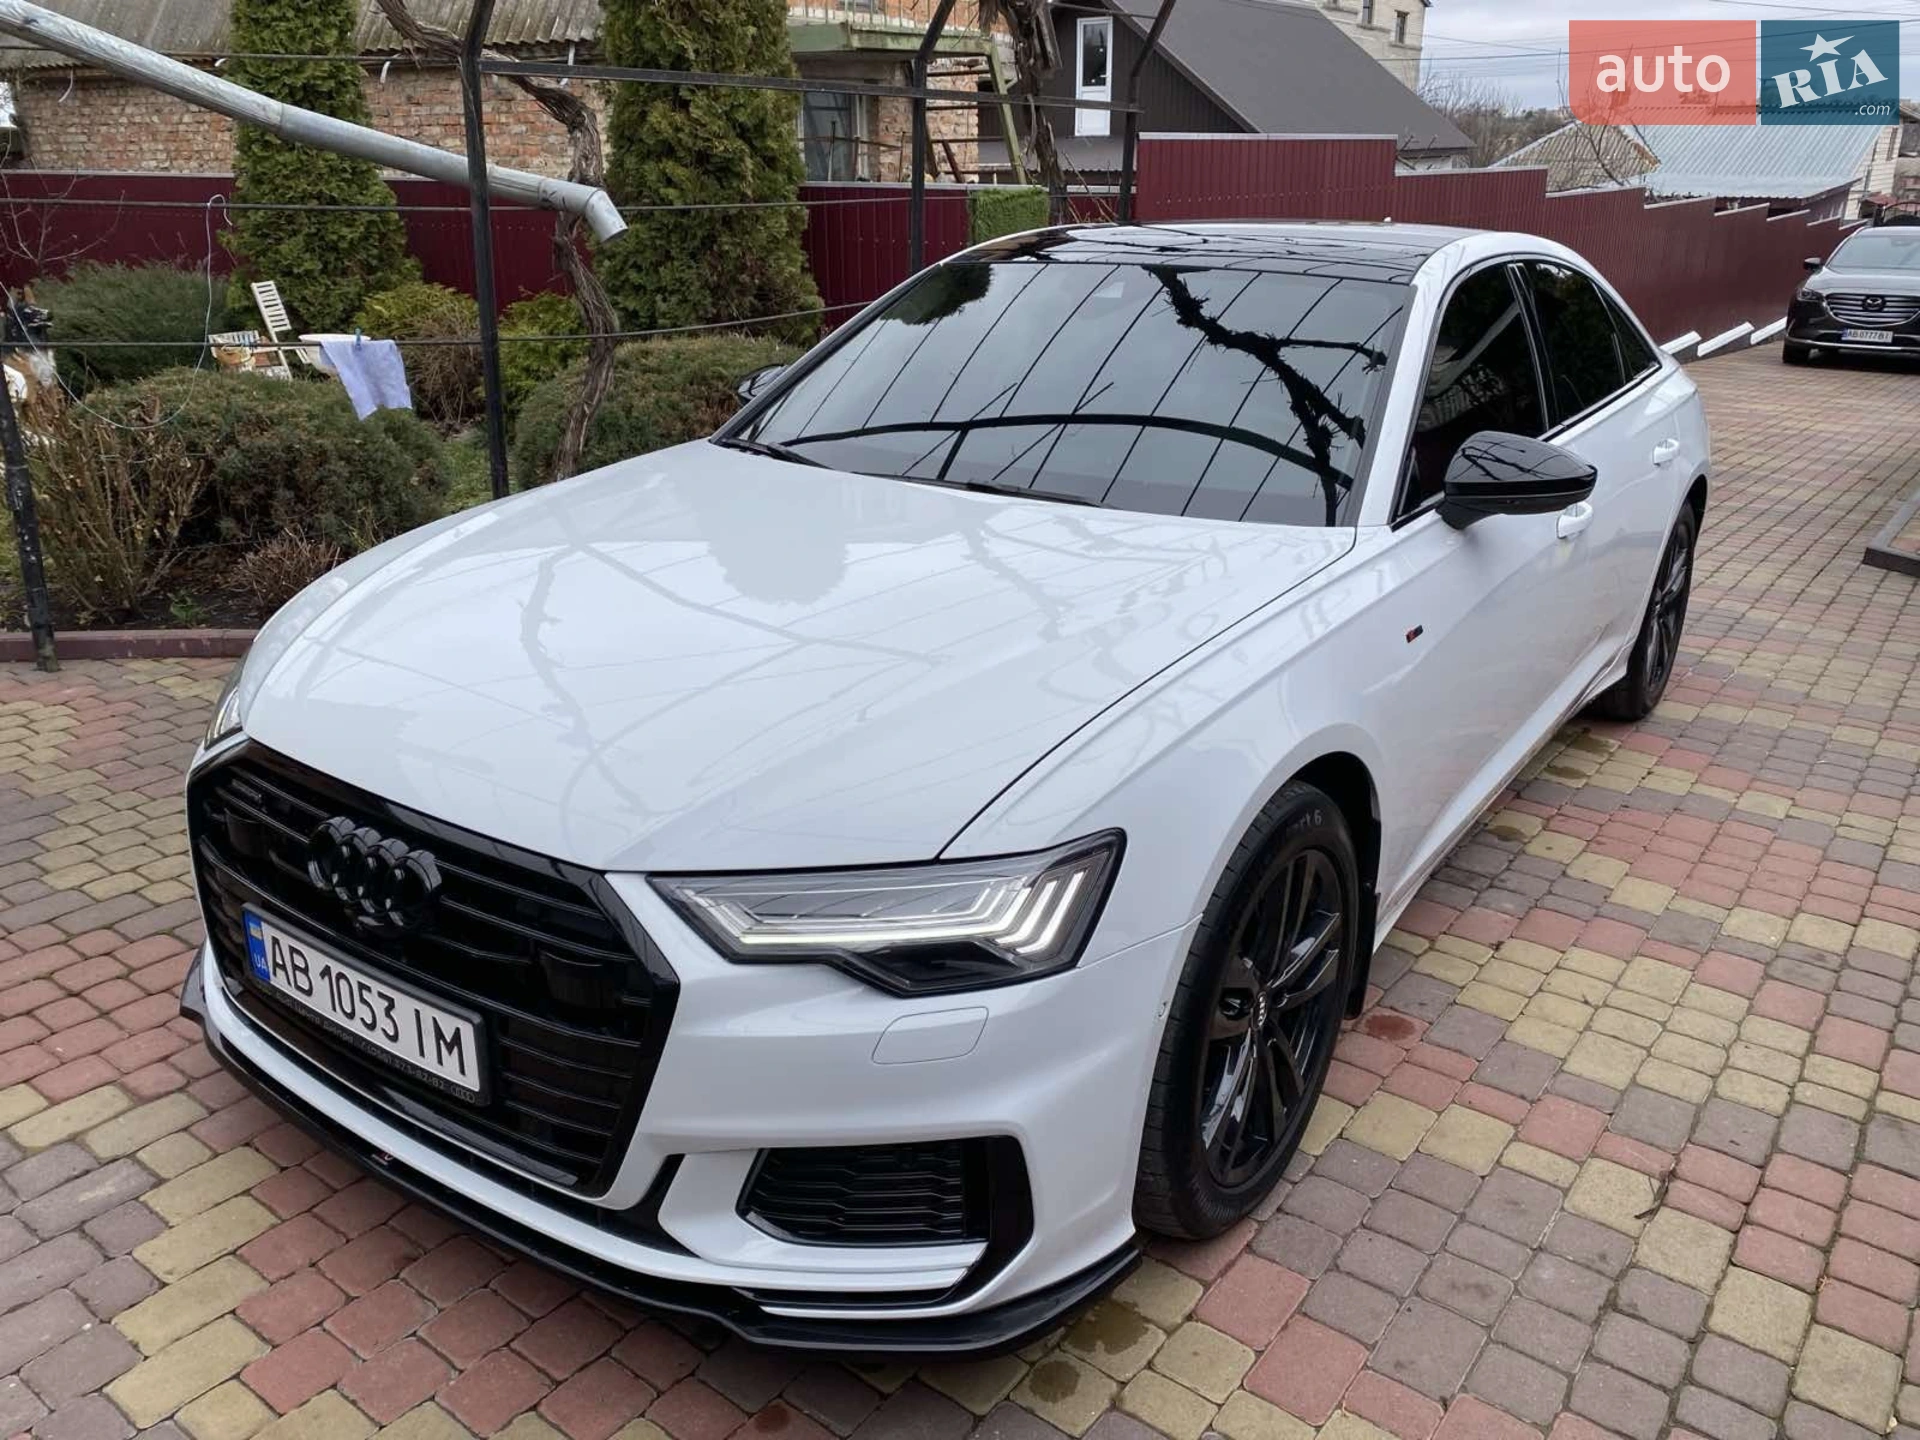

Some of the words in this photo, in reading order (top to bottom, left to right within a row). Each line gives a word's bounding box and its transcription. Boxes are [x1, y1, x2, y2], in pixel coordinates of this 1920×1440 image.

[254, 952, 269, 973] UA
[271, 935, 314, 997] AB
[319, 964, 399, 1043] 1053
[414, 1008, 466, 1076] IM
